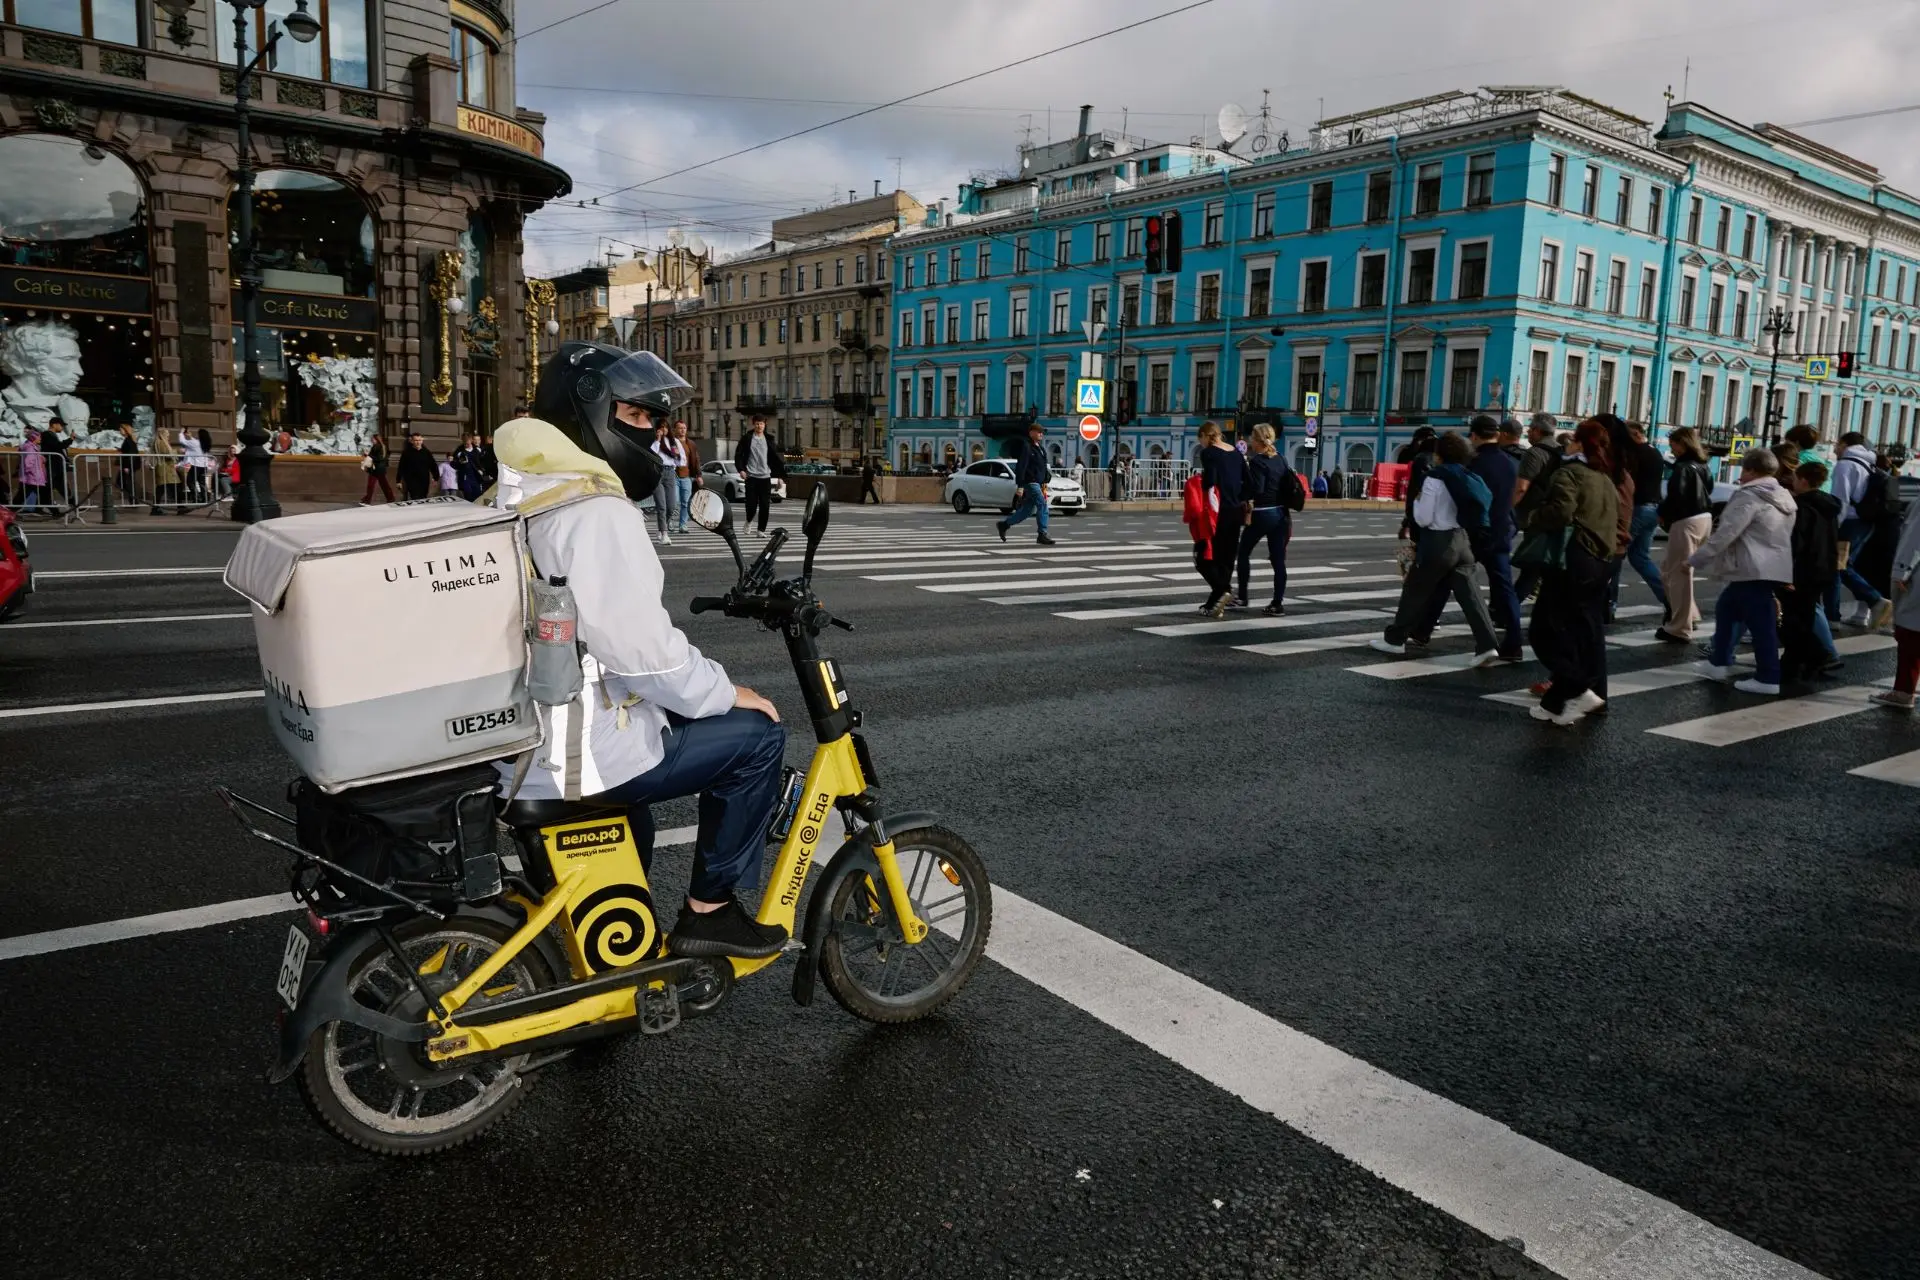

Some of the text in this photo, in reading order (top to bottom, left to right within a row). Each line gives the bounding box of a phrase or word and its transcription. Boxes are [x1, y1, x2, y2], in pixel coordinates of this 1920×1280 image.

[14, 278, 118, 299] Cafe René
[263, 300, 349, 319] Cafe René
[383, 551, 497, 583] ULTIMA
[431, 572, 500, 593] Яндекс Еда
[452, 708, 516, 736] UE2543
[562, 826, 620, 846] вело.рф
[566, 846, 617, 860] арендуй меня
[780, 792, 829, 907] Яндекс Еда
